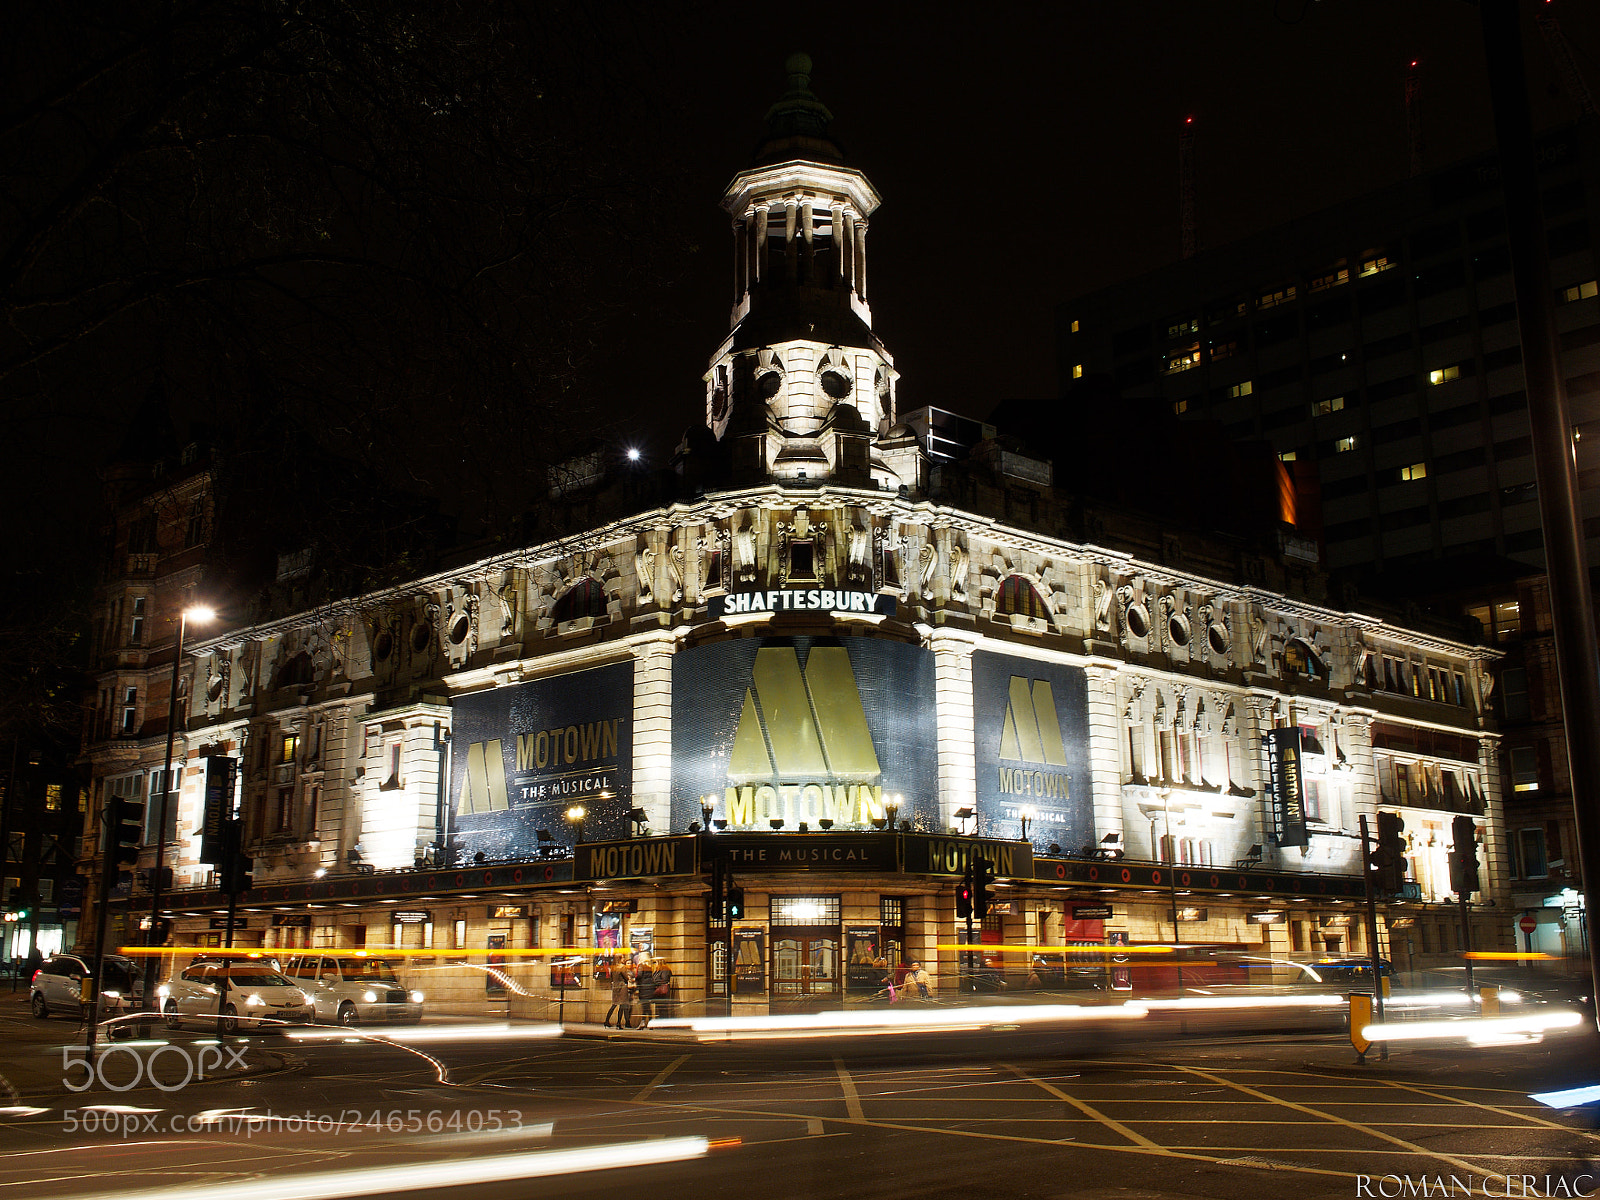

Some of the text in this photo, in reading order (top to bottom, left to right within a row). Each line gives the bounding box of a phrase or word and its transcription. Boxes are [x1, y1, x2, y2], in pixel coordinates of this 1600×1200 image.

[724, 590, 879, 614] SHAFTESBURY
[516, 719, 618, 772] MOTOWN
[522, 776, 610, 799] THE MUSICAL
[999, 767, 1070, 799] MOTOWN
[1269, 734, 1283, 842] SHAFTESBURY
[1284, 763, 1300, 816] MOTOWN
[725, 785, 882, 826] MOTOWN
[590, 842, 675, 878] MOTOWN
[730, 849, 869, 861] THE MUSICAL
